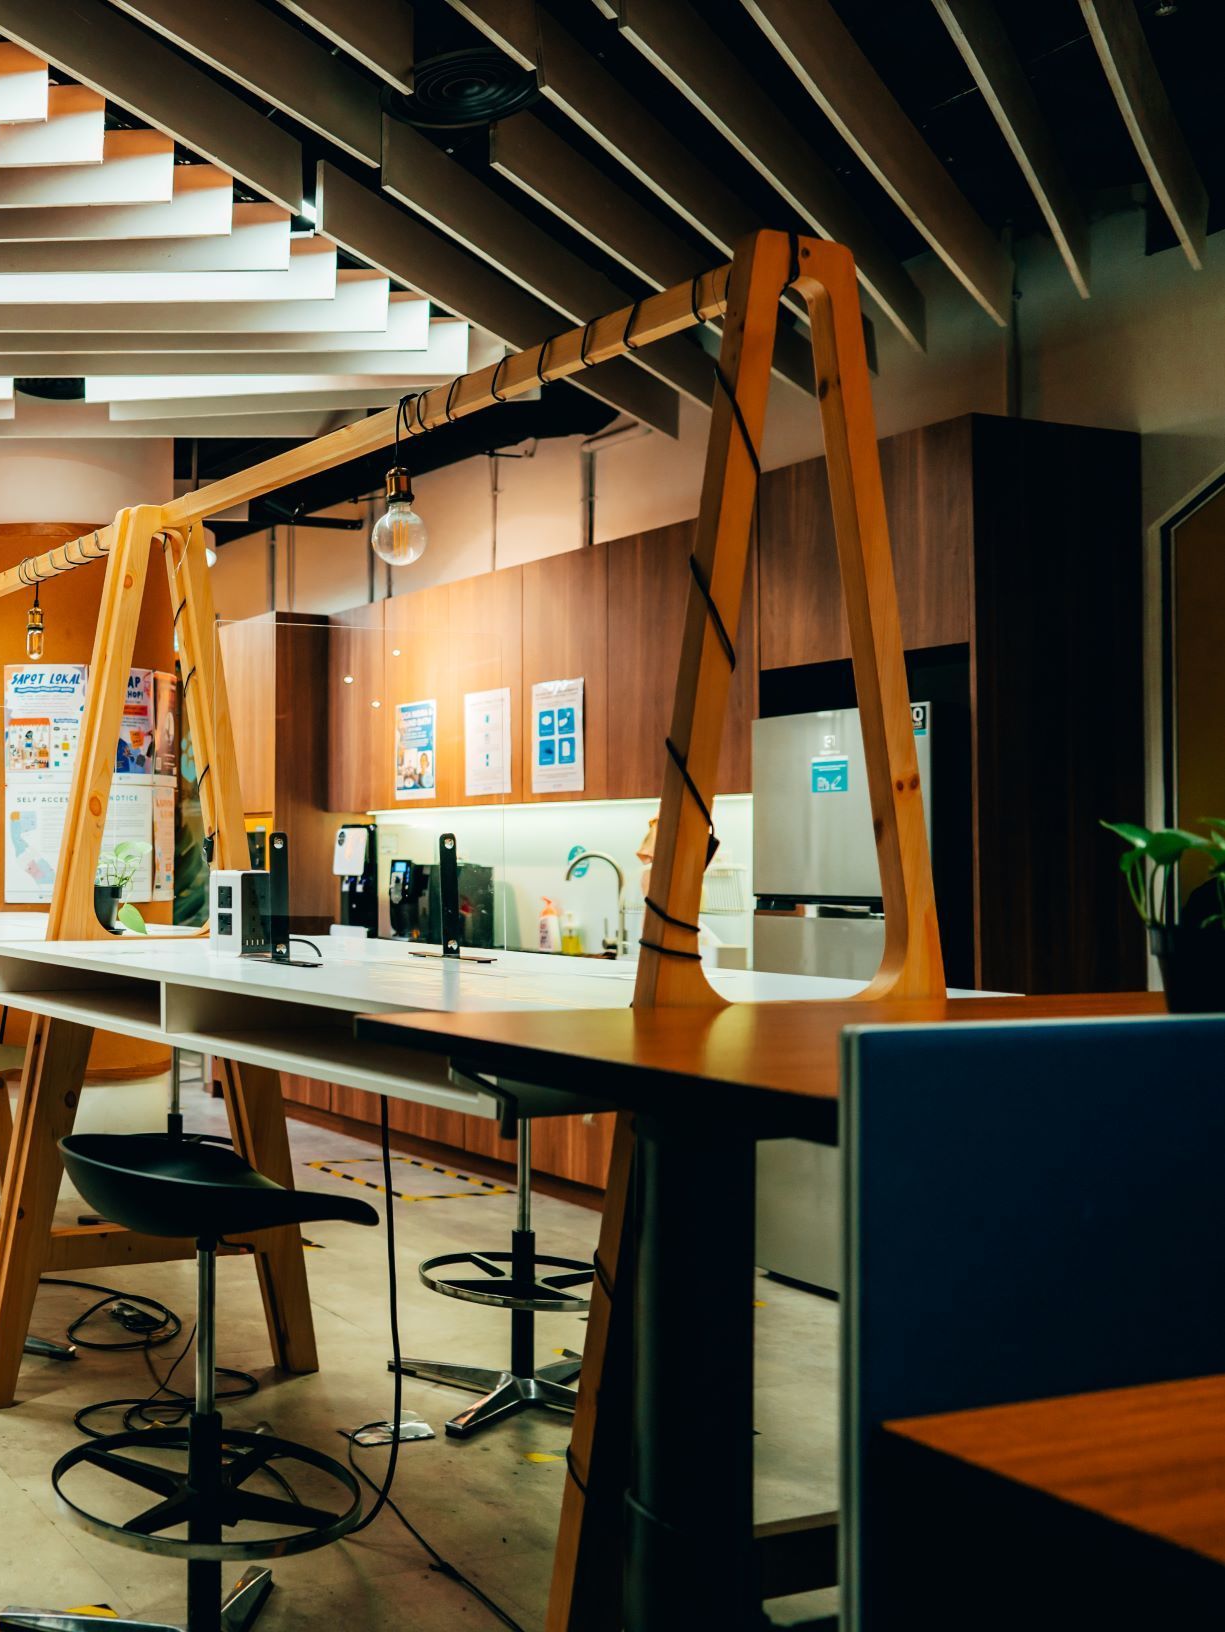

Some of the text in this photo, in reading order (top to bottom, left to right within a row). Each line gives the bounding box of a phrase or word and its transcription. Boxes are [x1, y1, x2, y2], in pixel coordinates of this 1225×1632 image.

[11, 672, 81, 685] SAPOT LOKAL
[127, 675, 141, 689] AP
[127, 690, 144, 700] HOP!
[912, 707, 924, 722] 0
